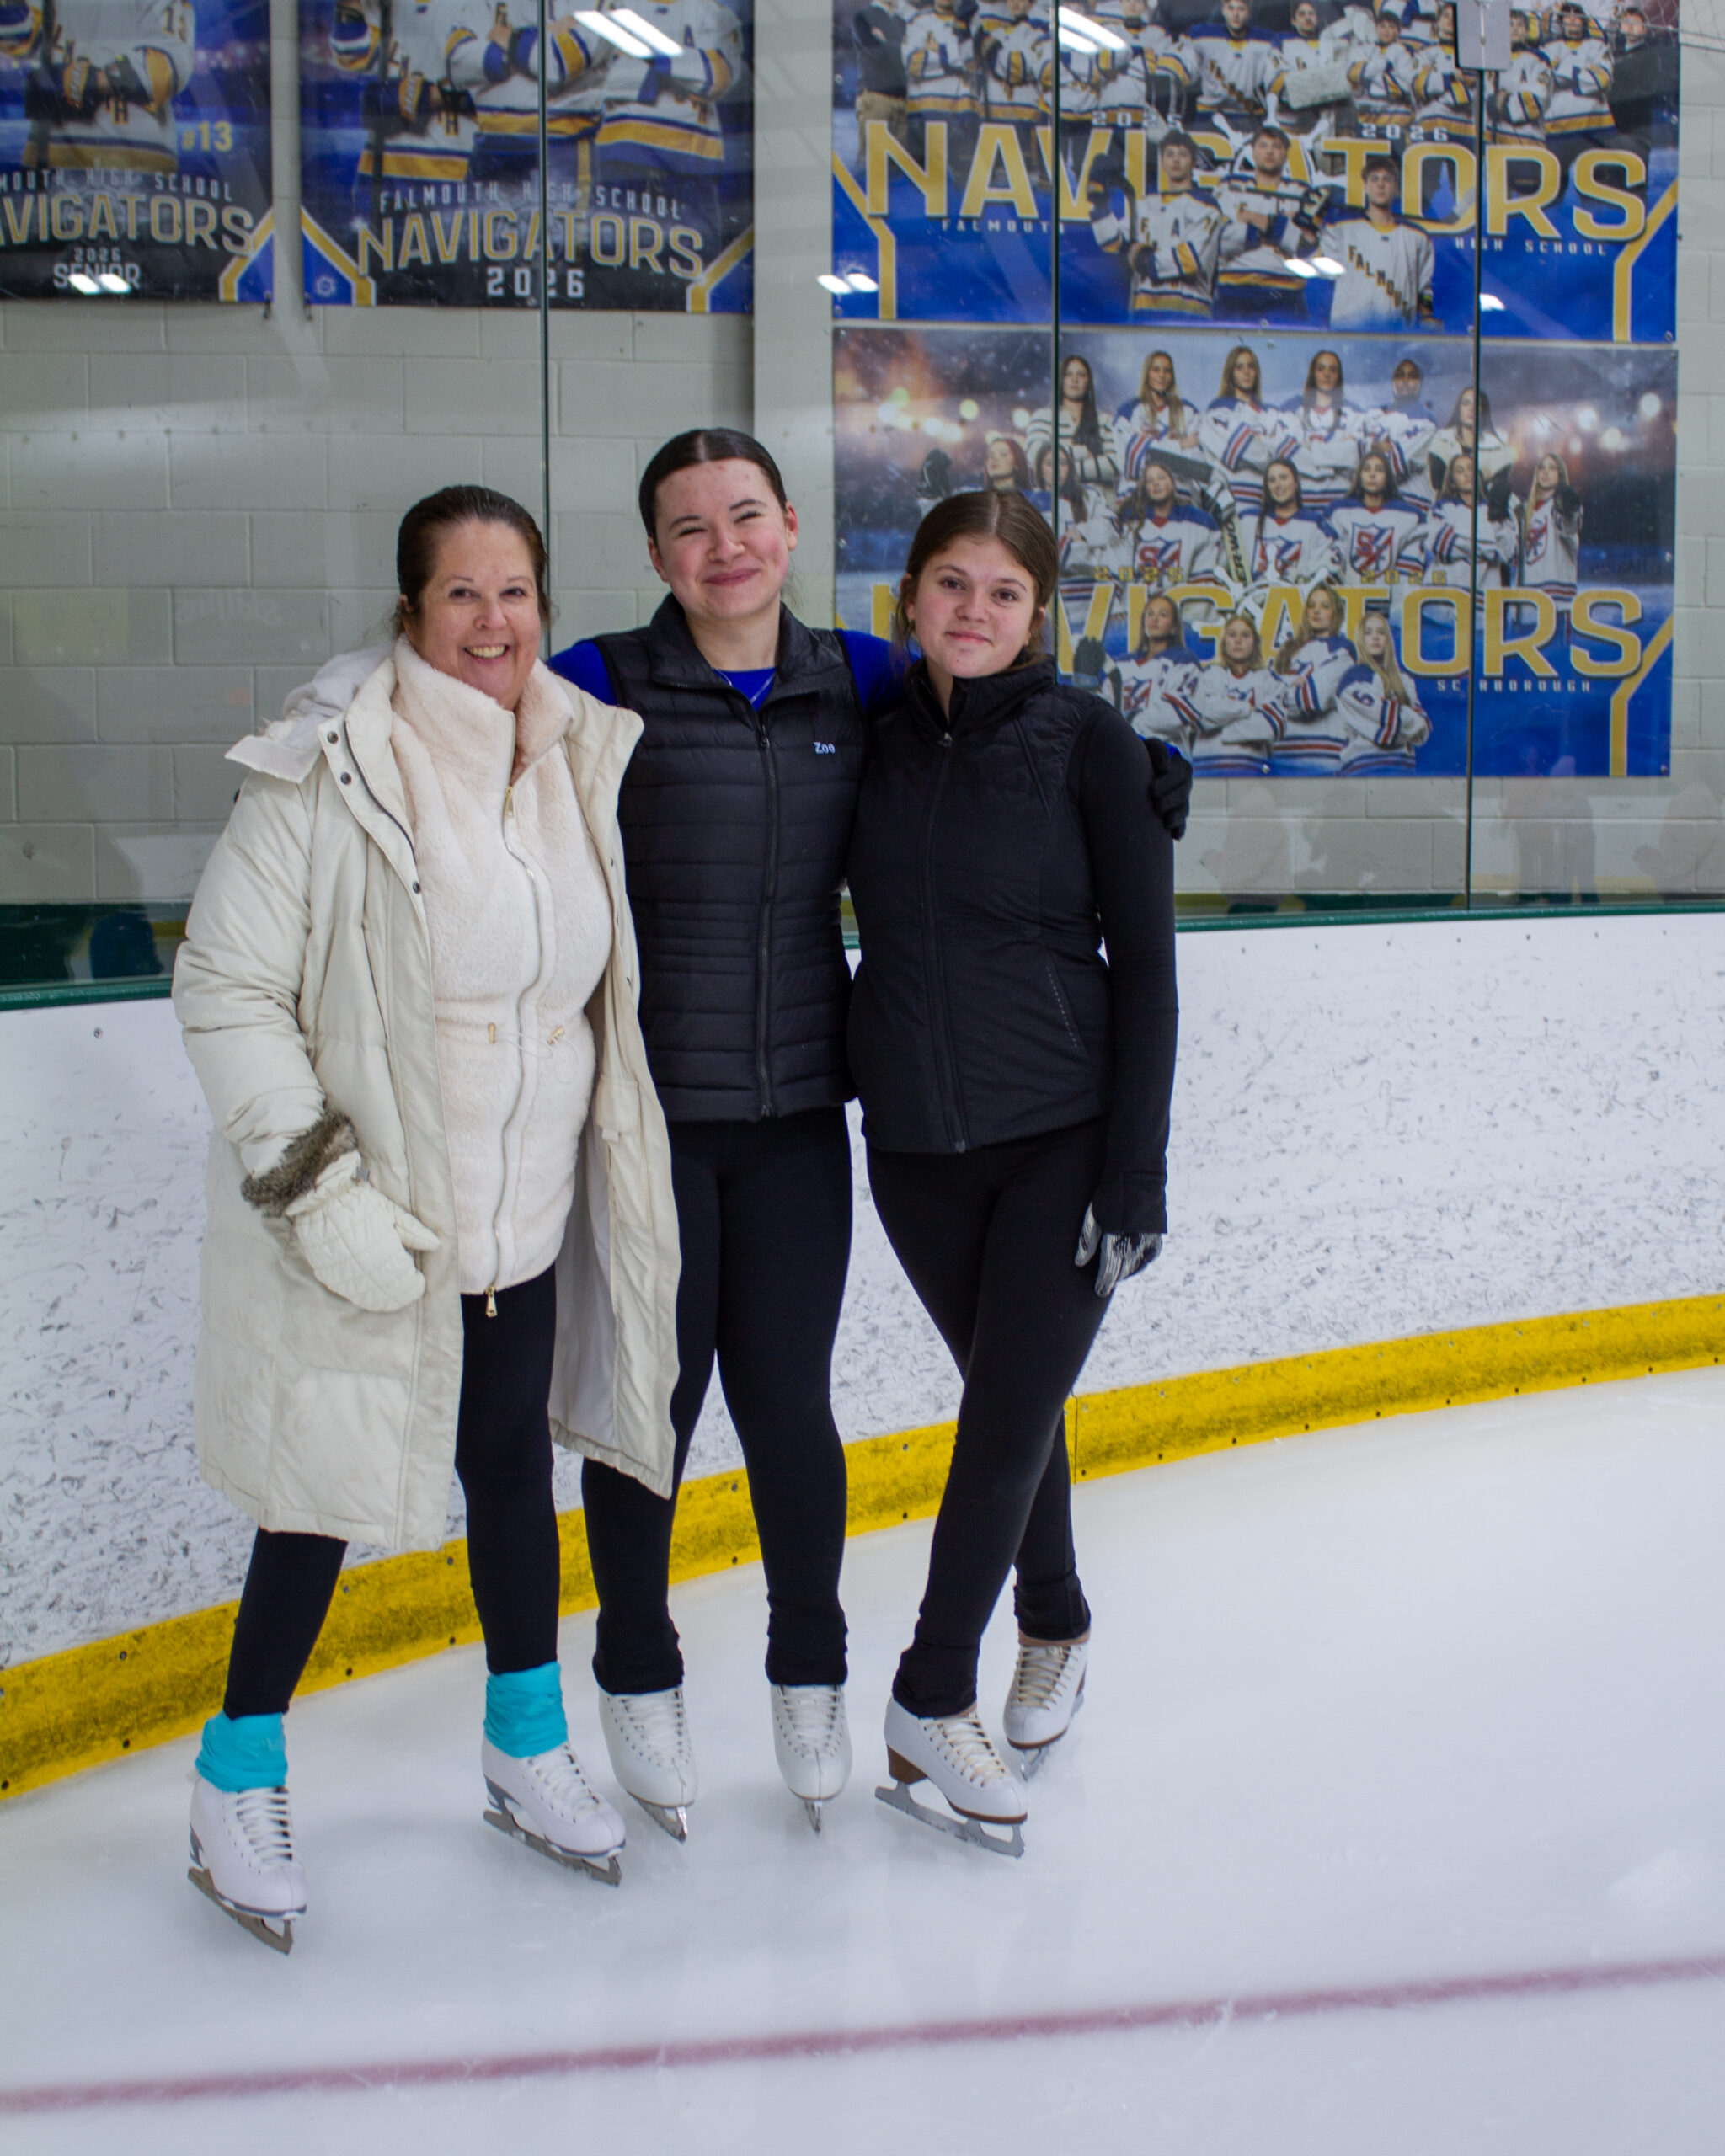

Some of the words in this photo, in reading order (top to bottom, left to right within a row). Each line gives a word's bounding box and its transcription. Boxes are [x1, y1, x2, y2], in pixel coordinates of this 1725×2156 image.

[181, 120, 233, 153] #13
[1361, 122, 1448, 142] 2026
[154, 173, 232, 202] SCHOOL
[380, 180, 499, 214] FALMOUTH
[522, 180, 572, 202] HGH
[596, 184, 681, 221] SCHOOL
[358, 209, 703, 280] NAVIGATORS
[1525, 239, 1615, 256] SCHOOL
[486, 266, 585, 298] 2026
[1437, 679, 1590, 692] SCRBOROUGH
[814, 741, 836, 754] Zoe
